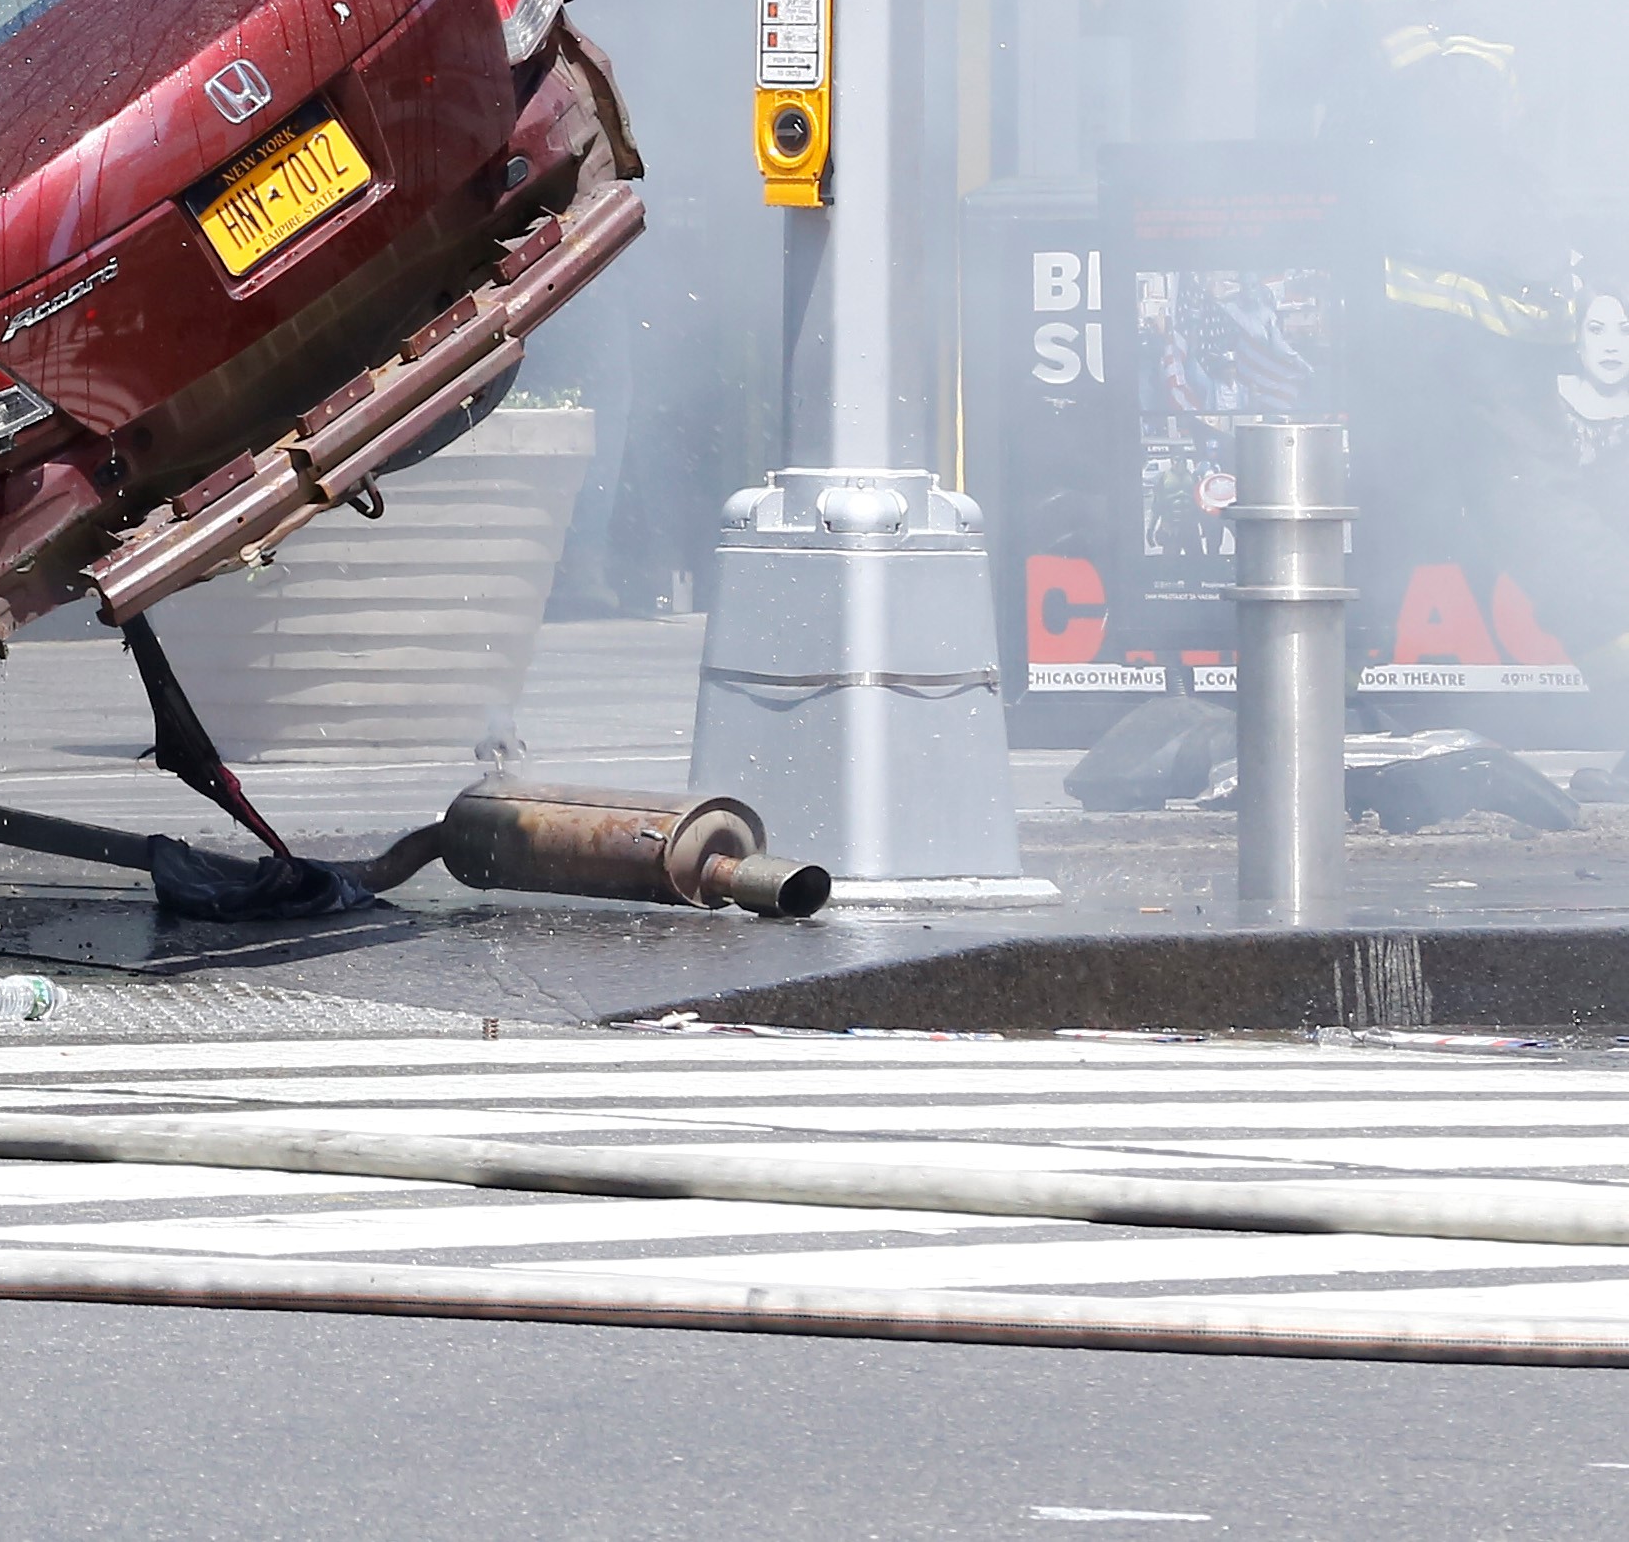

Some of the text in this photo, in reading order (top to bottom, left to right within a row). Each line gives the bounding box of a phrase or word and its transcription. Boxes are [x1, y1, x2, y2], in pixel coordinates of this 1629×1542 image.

[221, 125, 298, 187] NEW YORK
[215, 132, 349, 250] HNY 7012
[261, 189, 338, 248] EMPIRE STATE
[1, 256, 119, 343] Accord
[1403, 672, 1467, 687] THEATRE
